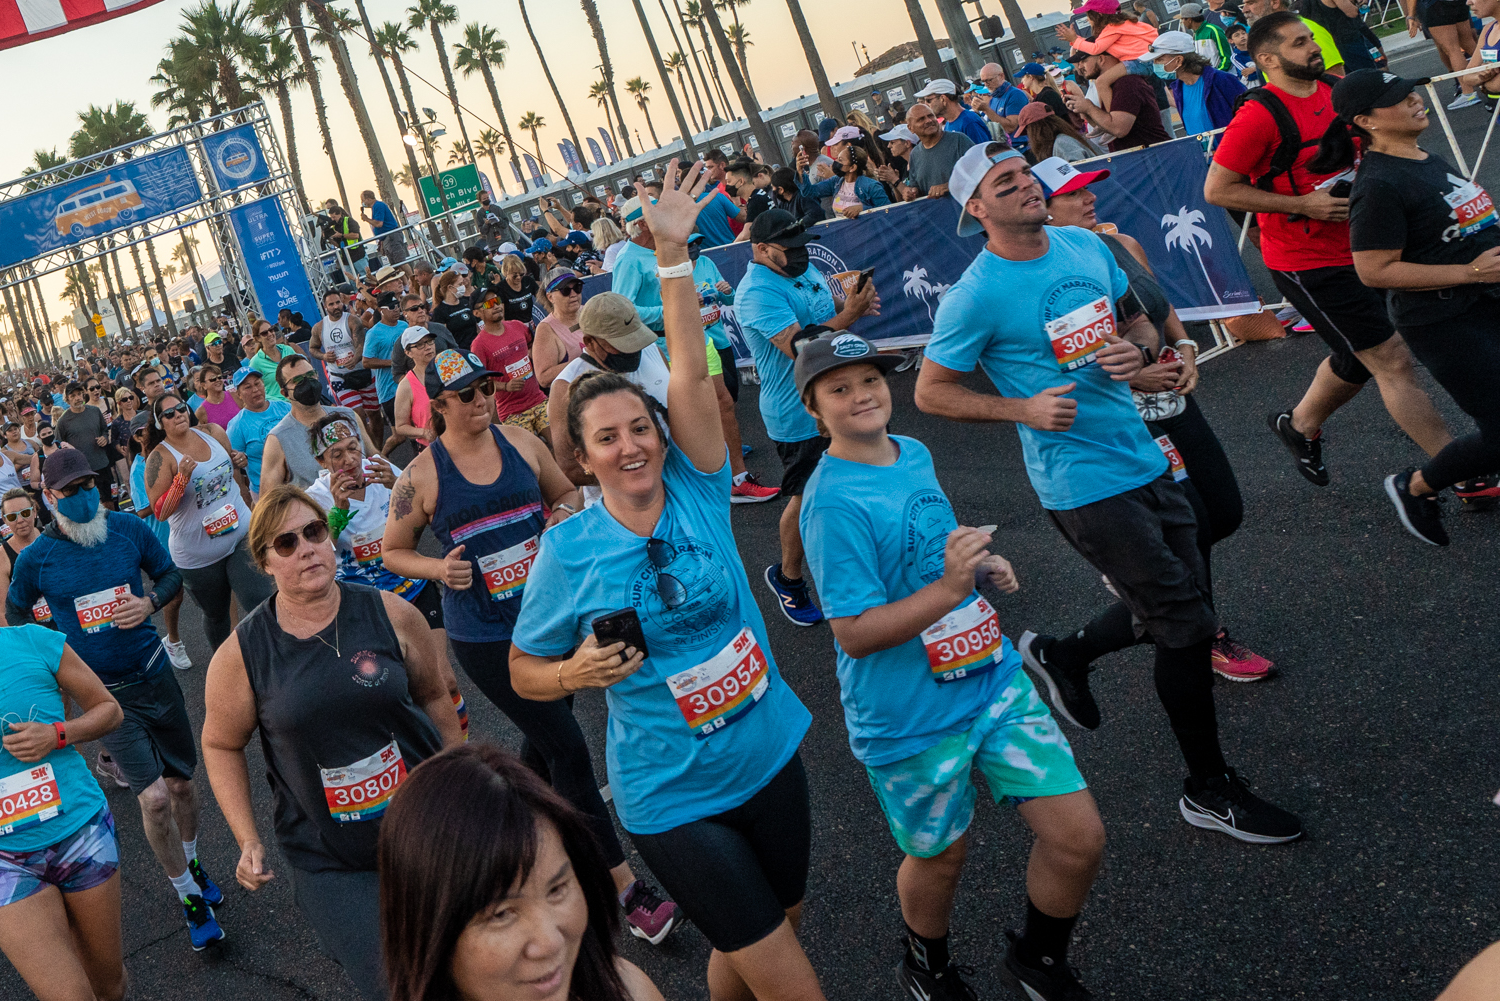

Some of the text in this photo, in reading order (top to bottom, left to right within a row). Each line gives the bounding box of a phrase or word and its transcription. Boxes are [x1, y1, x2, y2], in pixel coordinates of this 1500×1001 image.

[444, 177, 454, 186] 39
[429, 185, 478, 205] Bech Blvd
[247, 212, 268, 224] ULTRA
[254, 232, 274, 242] SUPER
[807, 248, 838, 266] RATHON
[268, 271, 289, 281] nuun
[277, 295, 298, 307] QURE
[1050, 280, 1105, 307] CITY MARATHO
[1093, 301, 1109, 314] 5K
[909, 502, 921, 523] CITY
[524, 539, 537, 552] 5K
[907, 524, 917, 553] SURF
[491, 558, 532, 586] 3037
[114, 586, 126, 596] 5K
[673, 607, 733, 646] 5K FINISHER
[733, 631, 750, 654] 5K
[937, 619, 1000, 662] 30956
[689, 654, 761, 715] 30954
[380, 745, 395, 764] 5K
[30, 766, 48, 781] 5K
[334, 764, 400, 805] 30807
